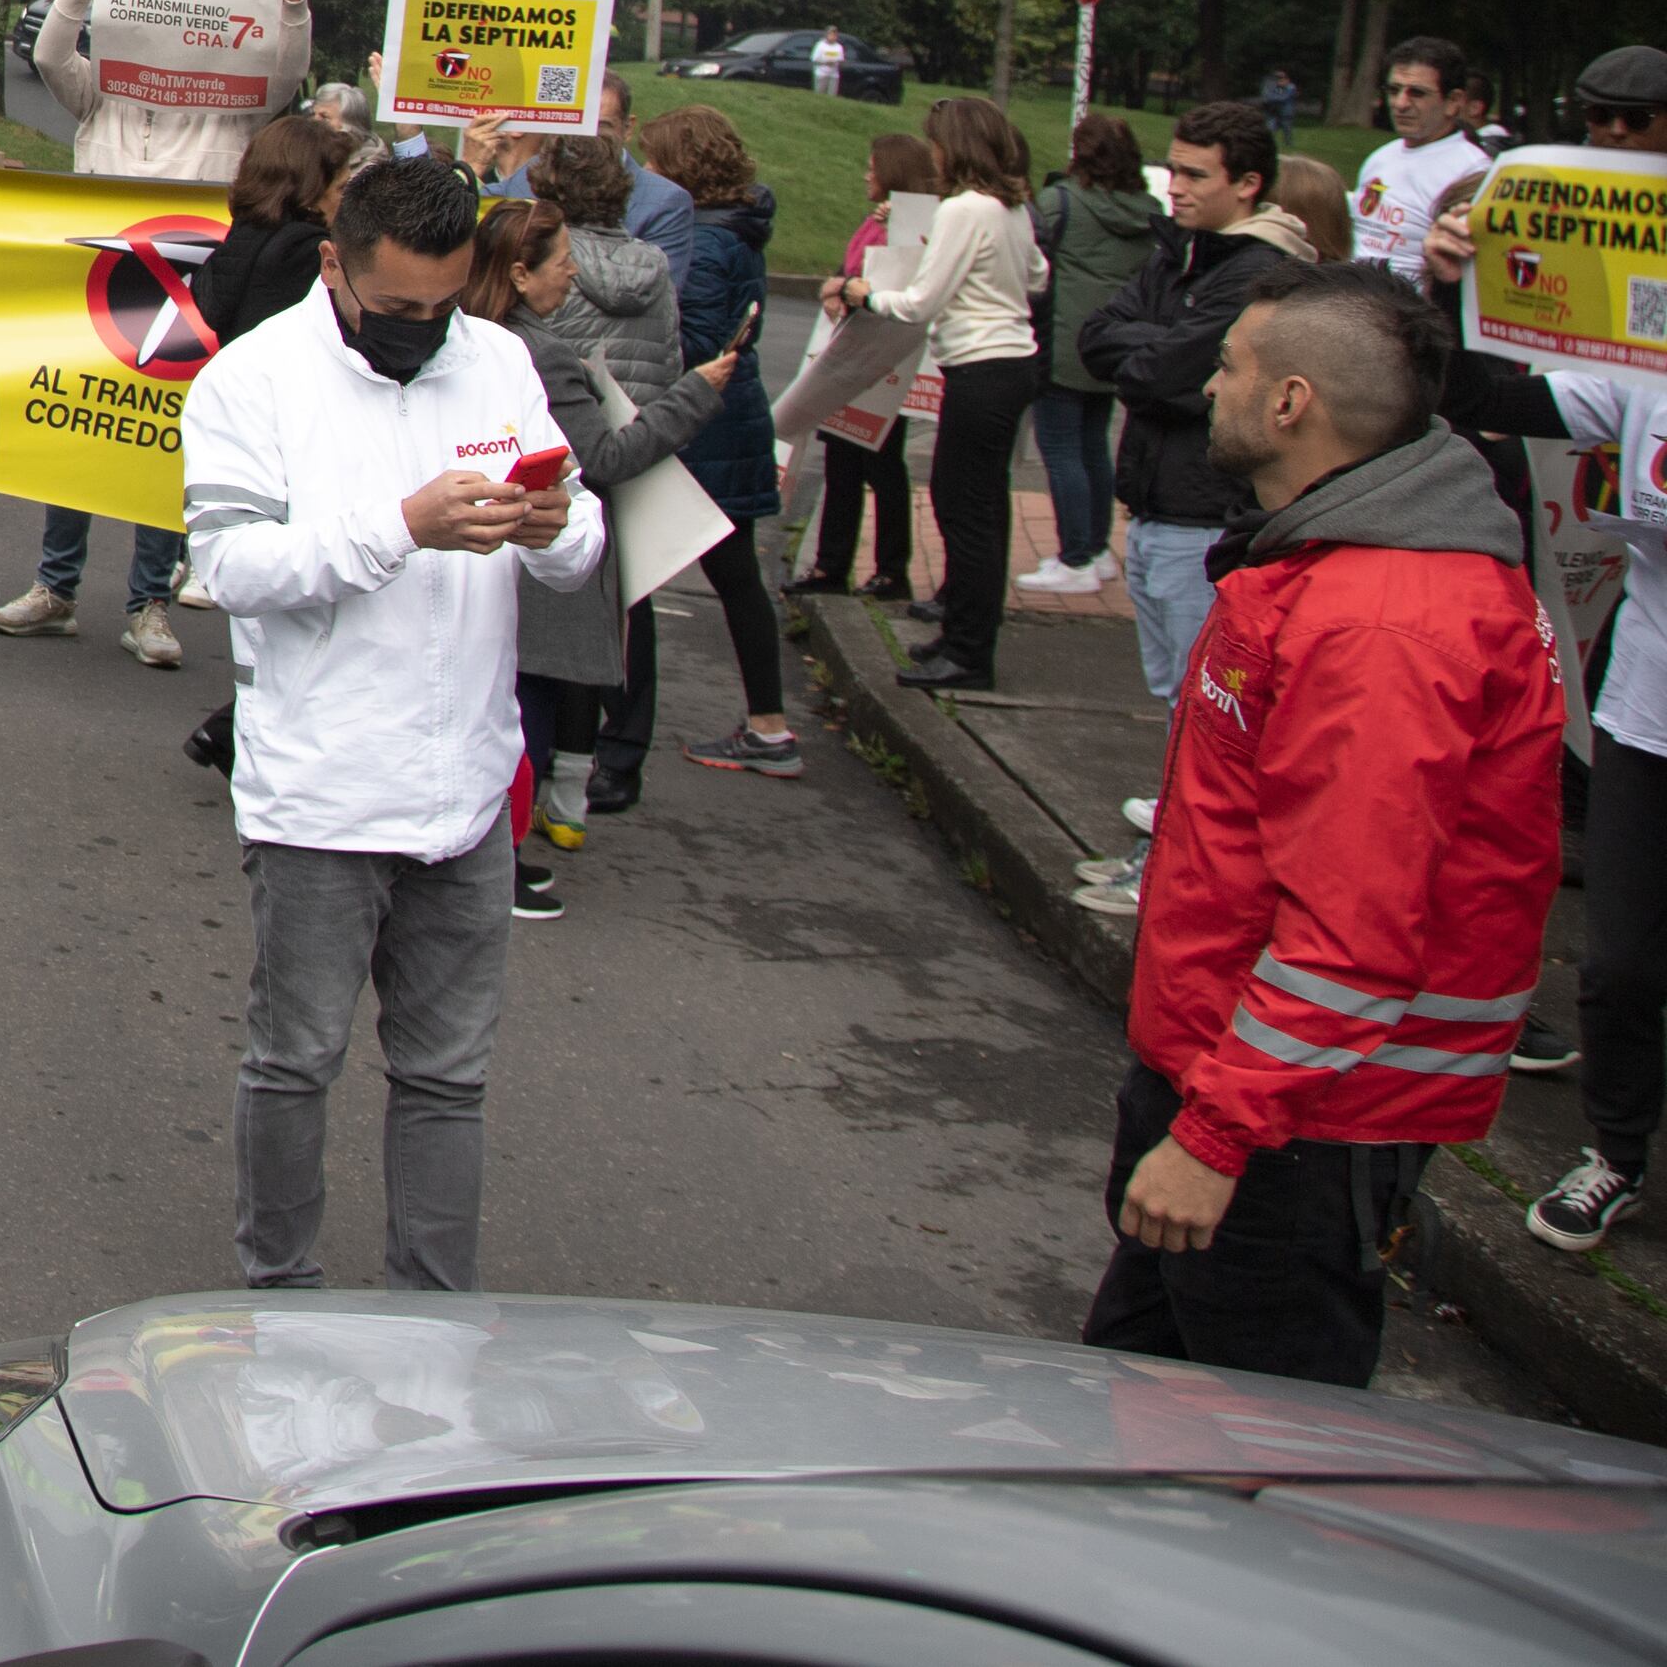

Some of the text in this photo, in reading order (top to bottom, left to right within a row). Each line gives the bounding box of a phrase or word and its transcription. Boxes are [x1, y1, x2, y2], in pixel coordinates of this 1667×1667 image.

[109, 8, 229, 33] CORREDOR VERDE
[423, 1, 577, 26] ¡DEFENDAMOS
[182, 30, 229, 49] CRA.
[421, 18, 575, 50] LA SÉPTIMA!
[138, 70, 226, 91] @NoTM7verde
[467, 67, 492, 81] NO
[1492, 178, 1667, 217] ¡DEFENDAMOS
[1378, 205, 1404, 226] NO
[1485, 199, 1667, 255] LA SÉPTIMA!
[1539, 275, 1567, 296] NO
[29, 365, 183, 419] AL TRANS
[25, 398, 183, 453] CORREDO
